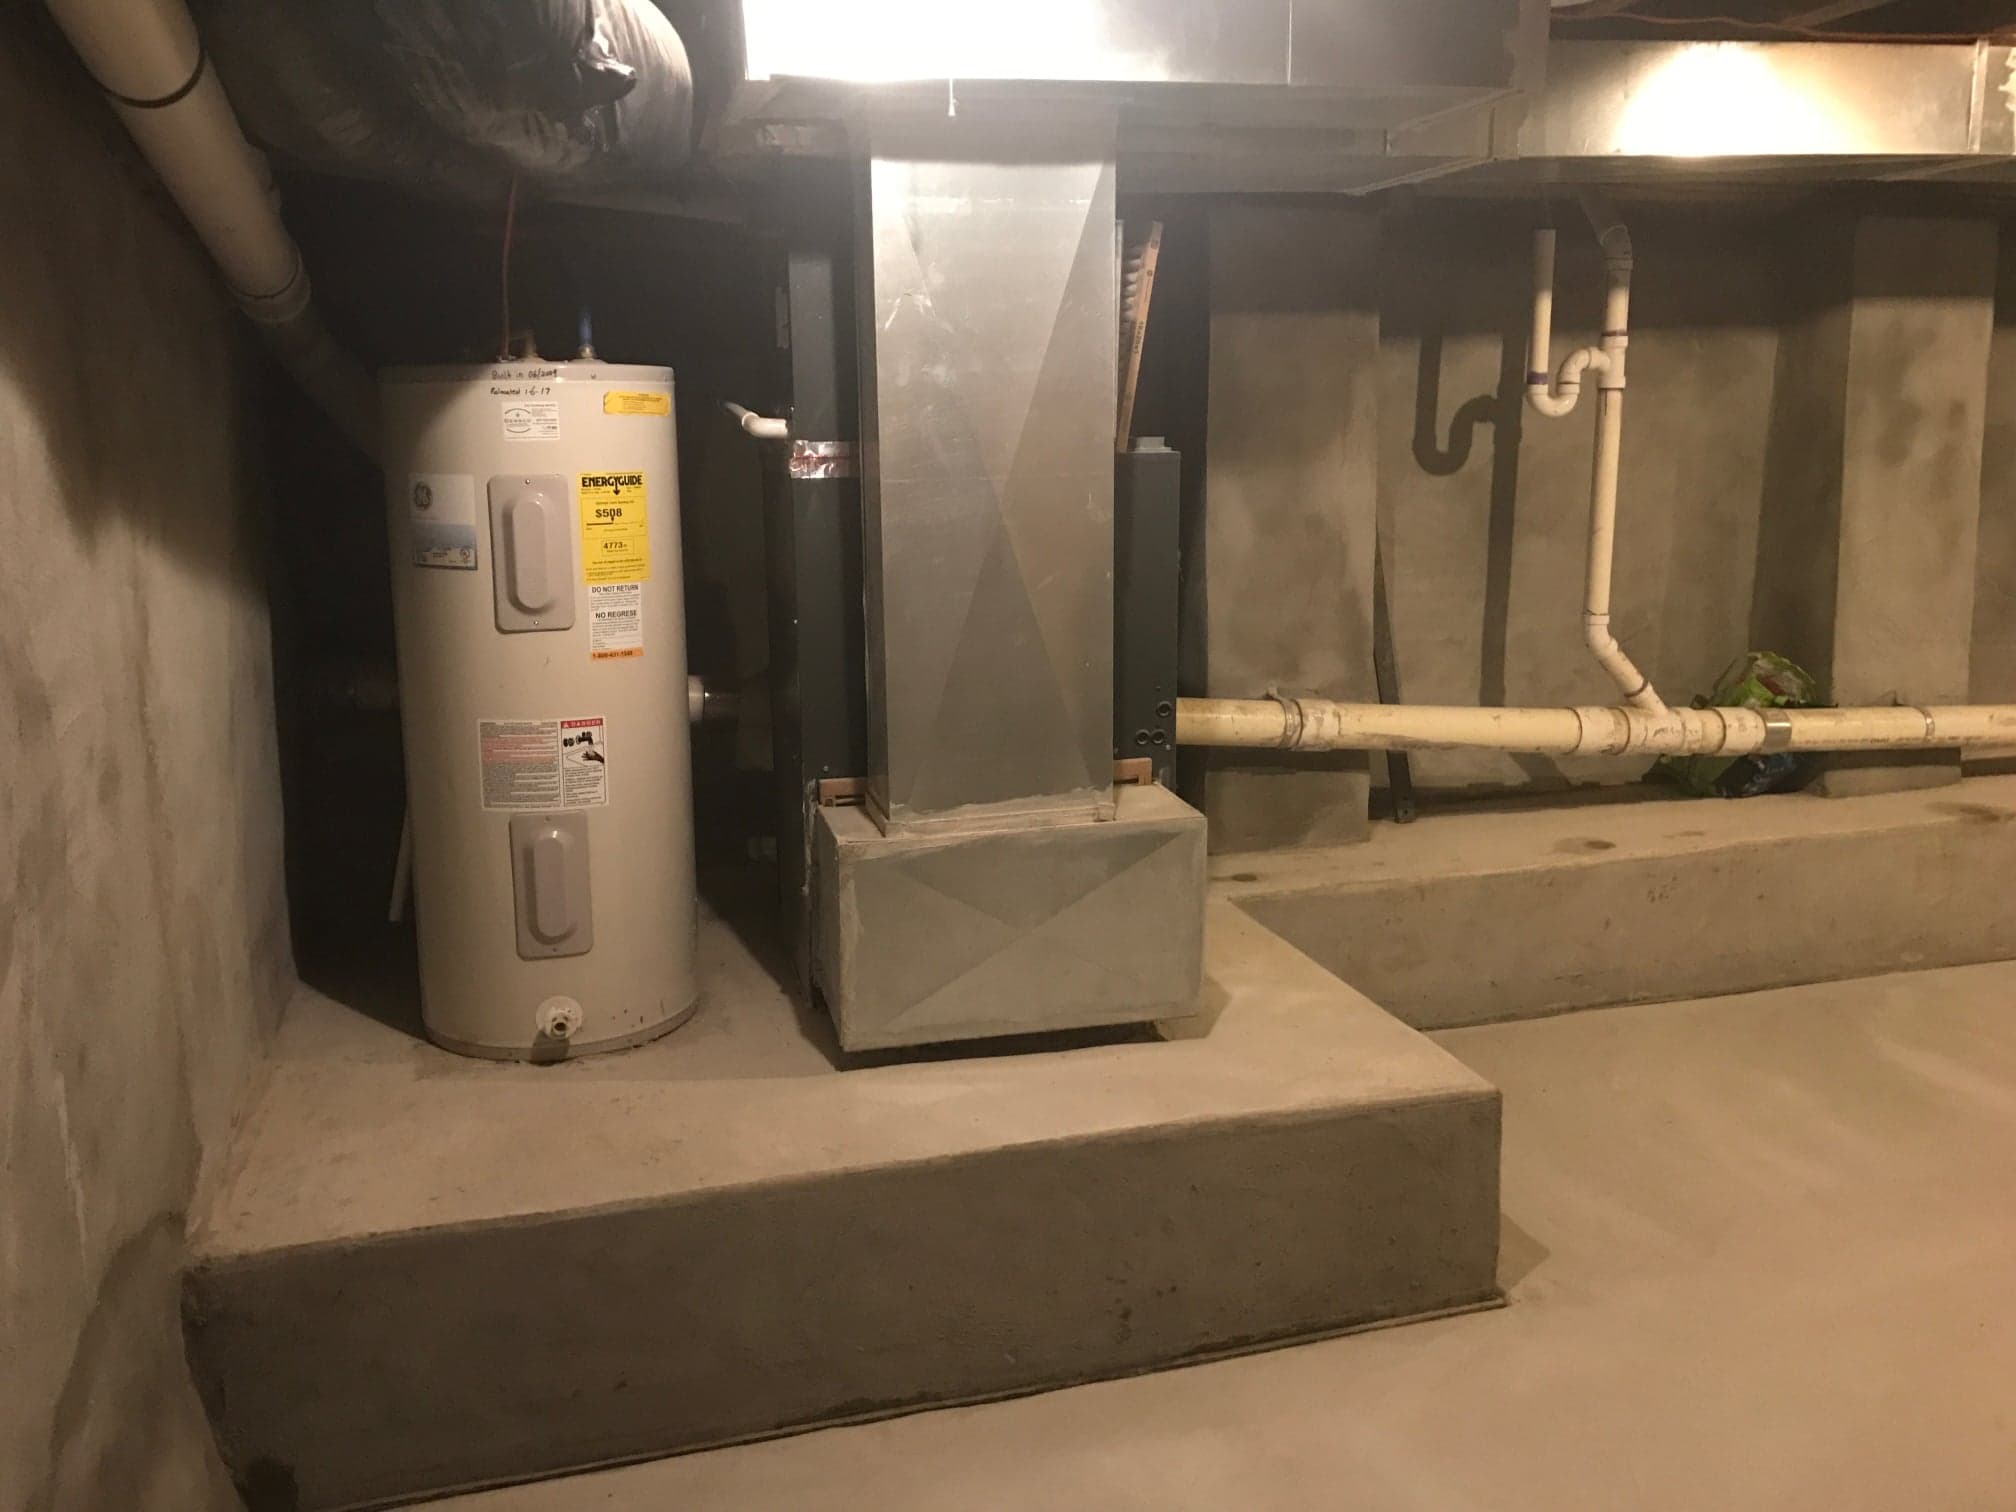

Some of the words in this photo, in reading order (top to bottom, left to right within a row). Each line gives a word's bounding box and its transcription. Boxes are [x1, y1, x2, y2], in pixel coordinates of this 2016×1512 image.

[582, 474, 643, 488] ENERGYGUIDE
[595, 508, 623, 519] $508
[603, 541, 623, 549] 4773
[591, 586, 602, 594] DO
[602, 585, 615, 593] NOT
[616, 584, 639, 592] RETURN
[607, 610, 637, 618] REGRESE
[571, 719, 601, 727] DANGER
